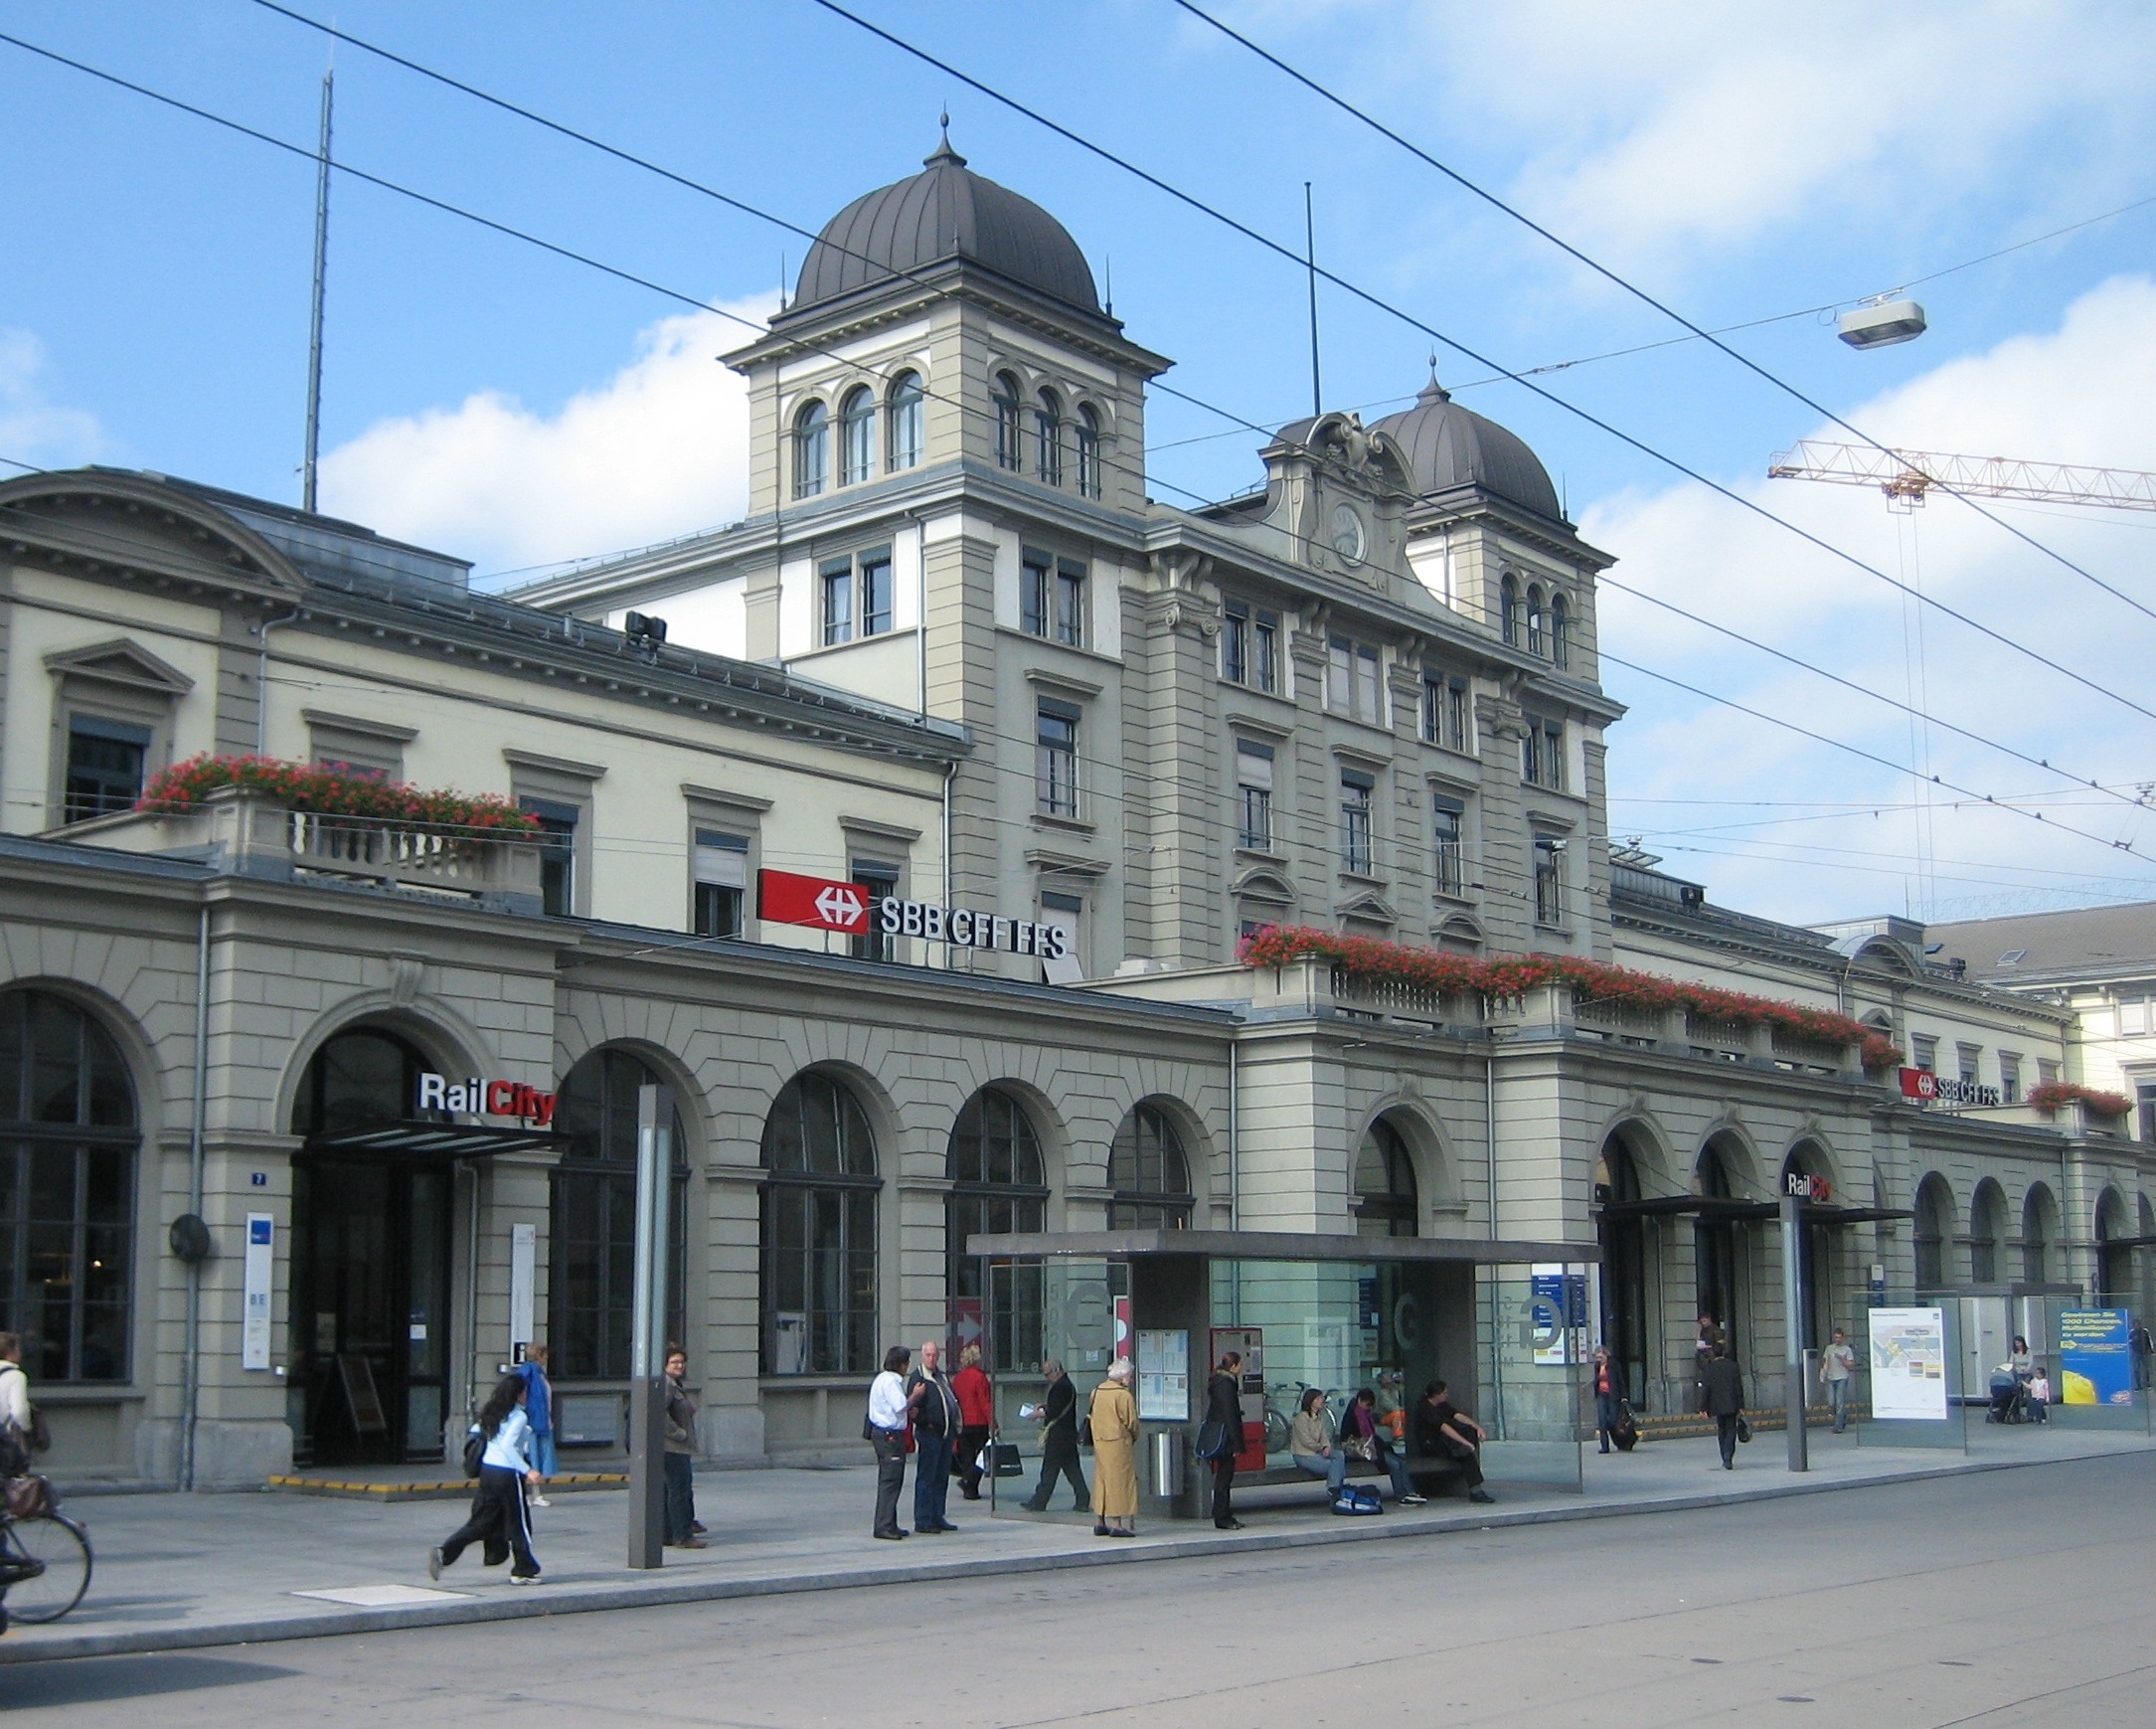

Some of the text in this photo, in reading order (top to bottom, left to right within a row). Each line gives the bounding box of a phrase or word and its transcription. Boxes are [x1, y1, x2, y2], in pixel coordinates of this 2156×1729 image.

[881, 896, 1068, 960] SBB CFF FFS
[419, 1072, 558, 1126] RailCity
[1937, 1078, 1959, 1100] SBB
